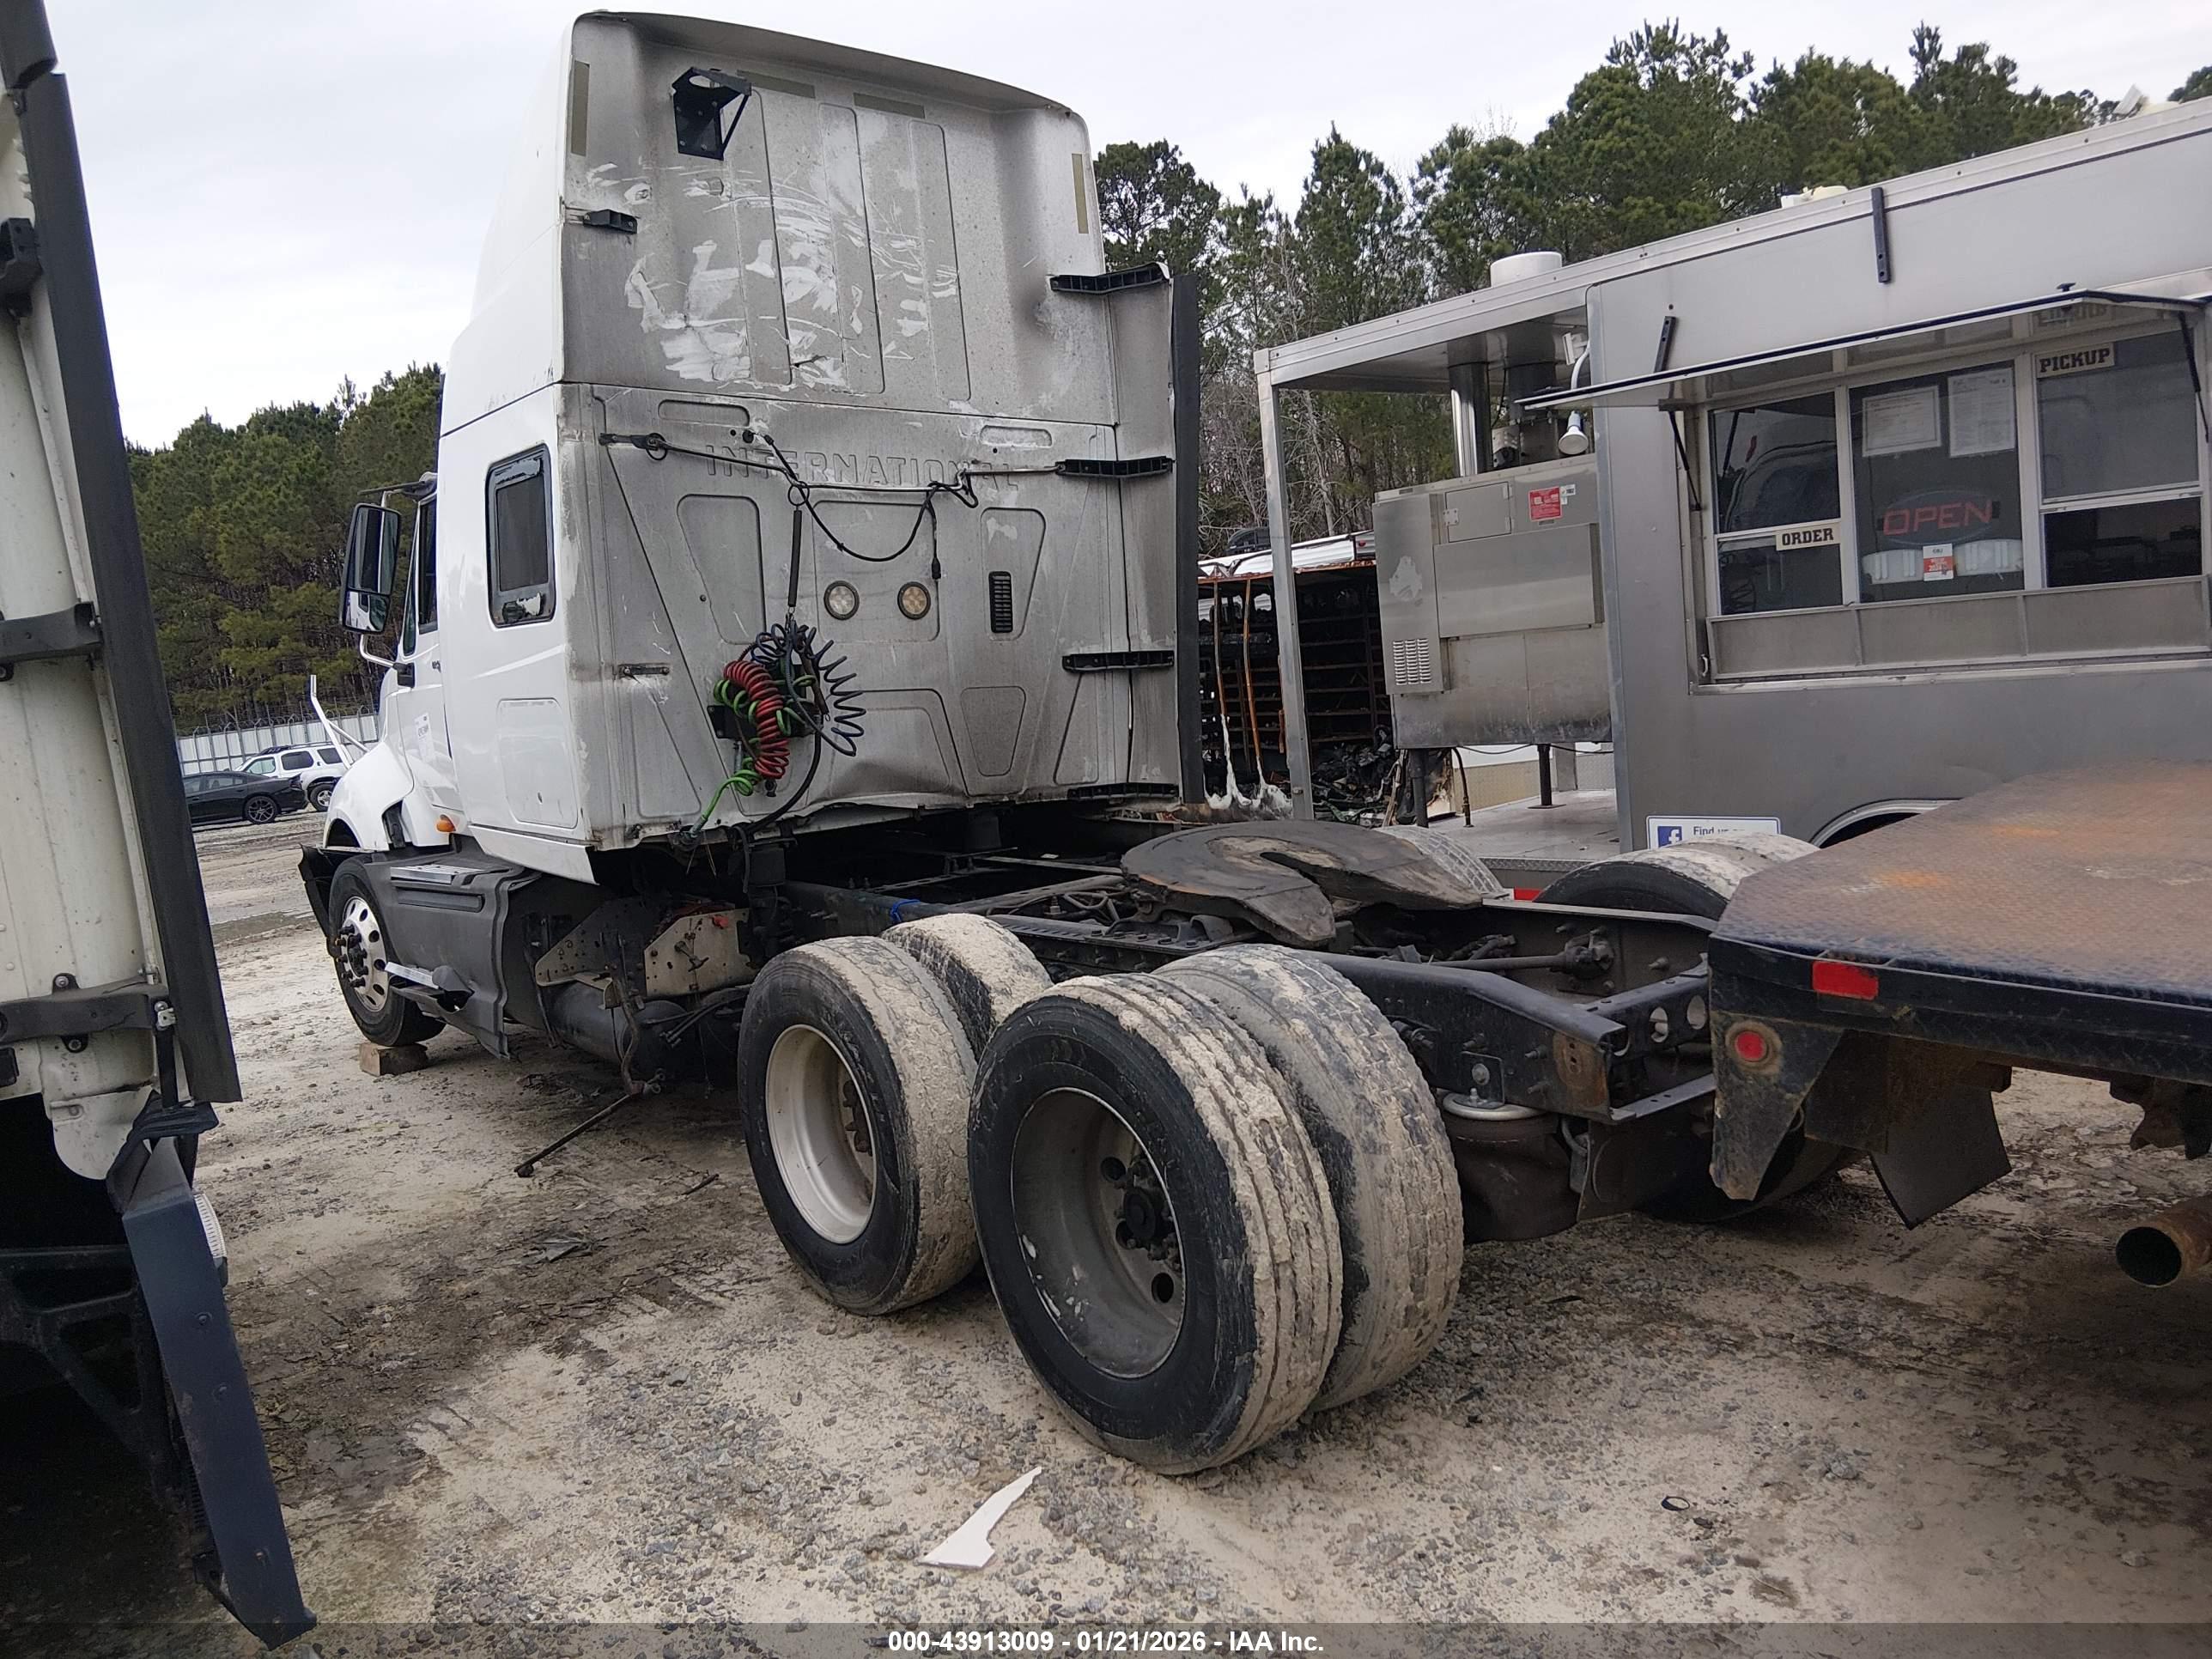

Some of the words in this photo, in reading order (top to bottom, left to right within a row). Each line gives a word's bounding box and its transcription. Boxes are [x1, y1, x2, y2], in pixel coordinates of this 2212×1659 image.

[2039, 349, 2110, 373] PICKUP
[1883, 500, 1993, 536] OPEN
[1782, 527, 1833, 545] ORDER
